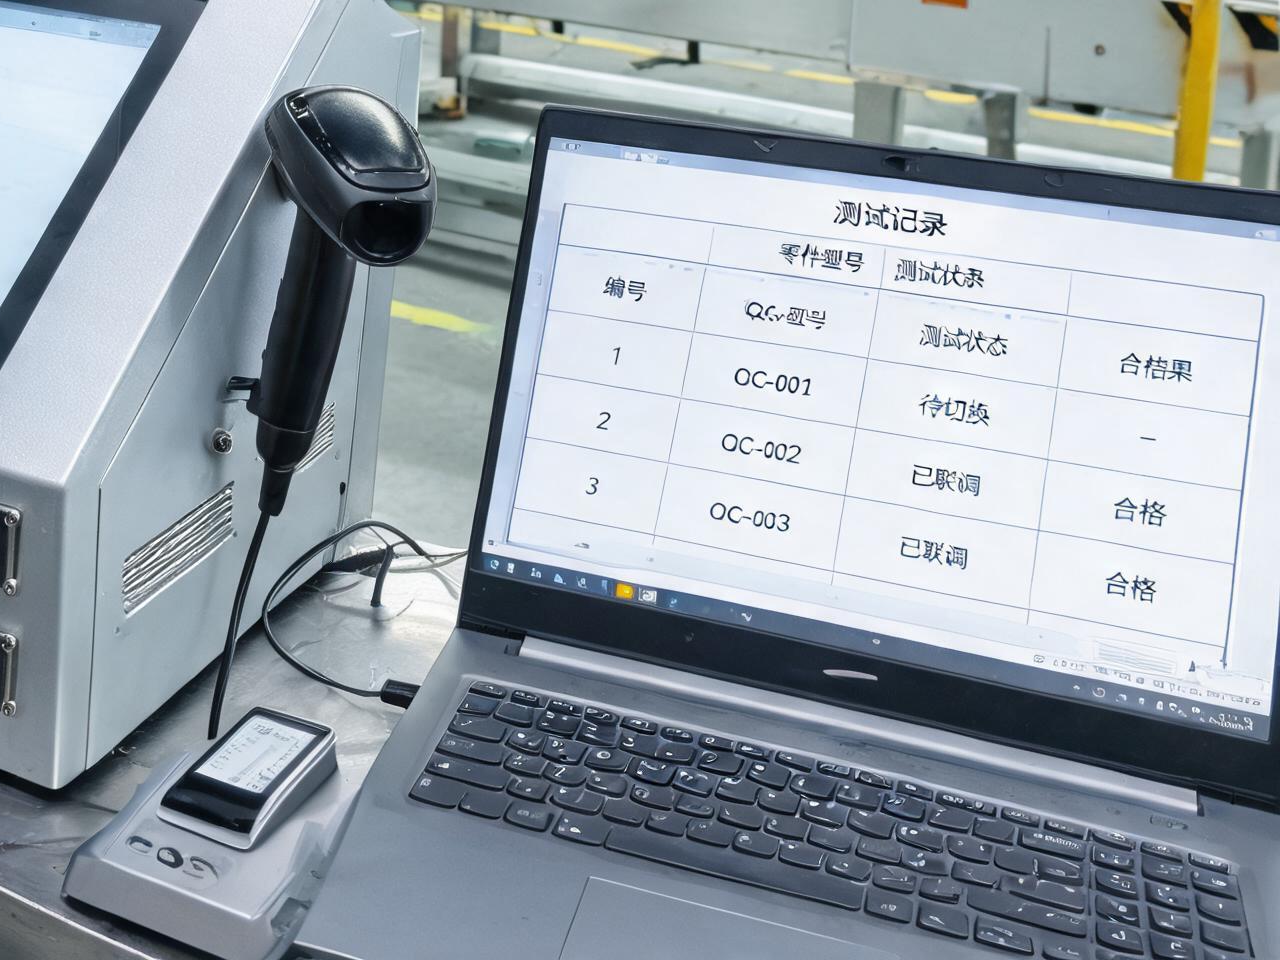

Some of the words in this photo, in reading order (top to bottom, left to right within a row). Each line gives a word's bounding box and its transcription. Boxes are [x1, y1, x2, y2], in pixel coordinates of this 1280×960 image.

[612, 346, 621, 366] 1
[734, 367, 812, 396] OC-001
[596, 411, 612, 431] 2
[721, 433, 802, 464] OC-002
[585, 476, 600, 496] 3
[709, 502, 791, 532] OC-003
[1113, 497, 1168, 527] 合格
[1105, 571, 1157, 604] 合格
